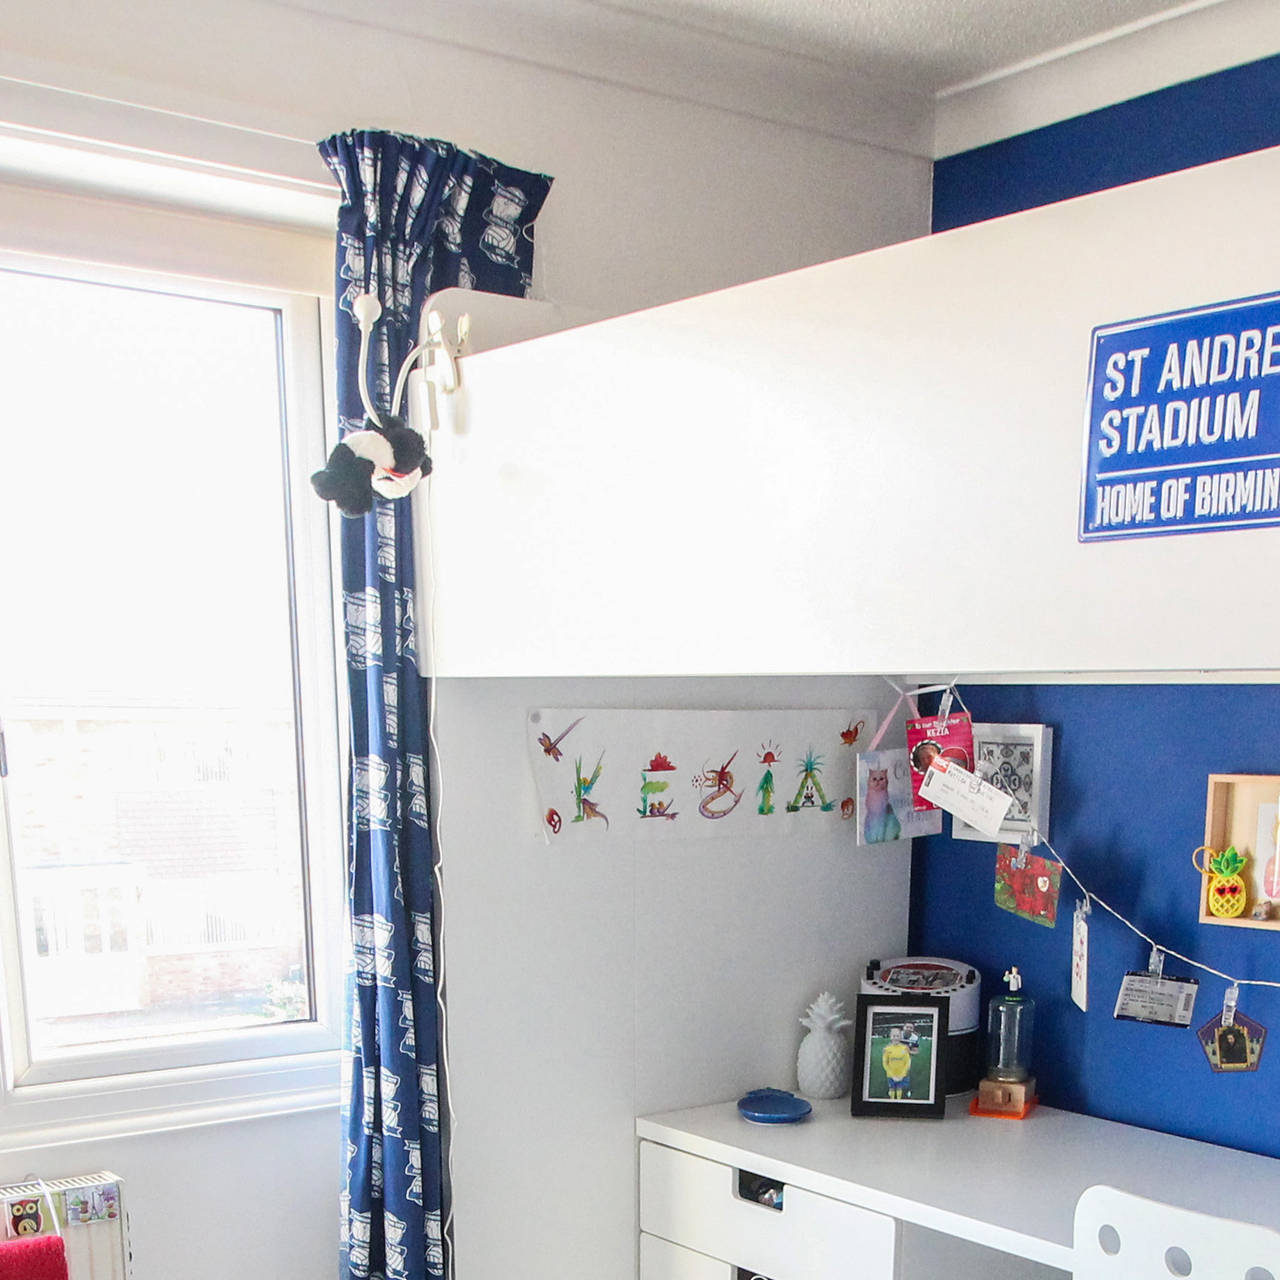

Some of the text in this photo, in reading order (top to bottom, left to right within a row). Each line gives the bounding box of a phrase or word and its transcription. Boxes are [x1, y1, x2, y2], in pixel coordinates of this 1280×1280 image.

[1103, 347, 1150, 402] ST
[1098, 388, 1262, 458] STADIUM
[1095, 477, 1157, 527] HOME
[1160, 477, 1193, 520] OF
